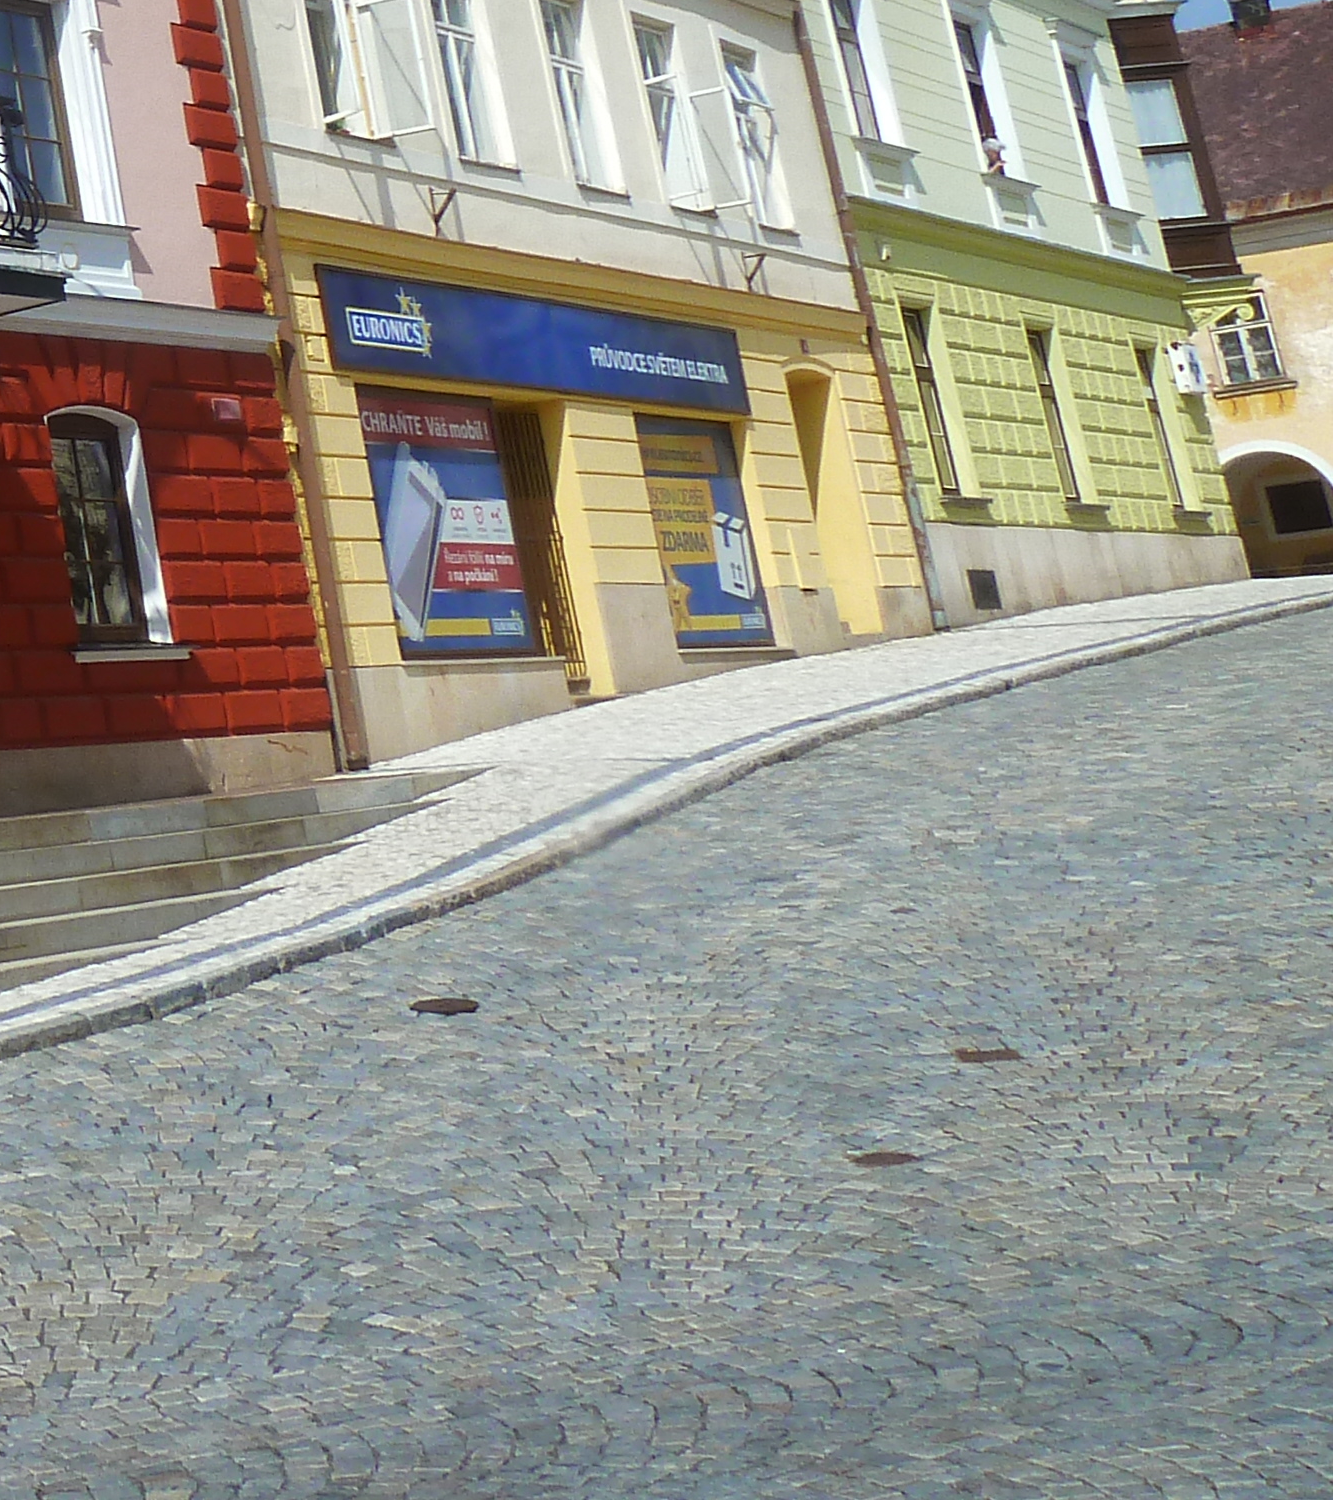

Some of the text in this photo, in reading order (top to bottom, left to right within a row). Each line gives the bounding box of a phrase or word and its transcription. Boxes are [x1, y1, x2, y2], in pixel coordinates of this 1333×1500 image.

[351, 314, 423, 346] EURONICS
[361, 409, 423, 436] CHRAŇTE
[660, 530, 709, 552] ZDARMA
